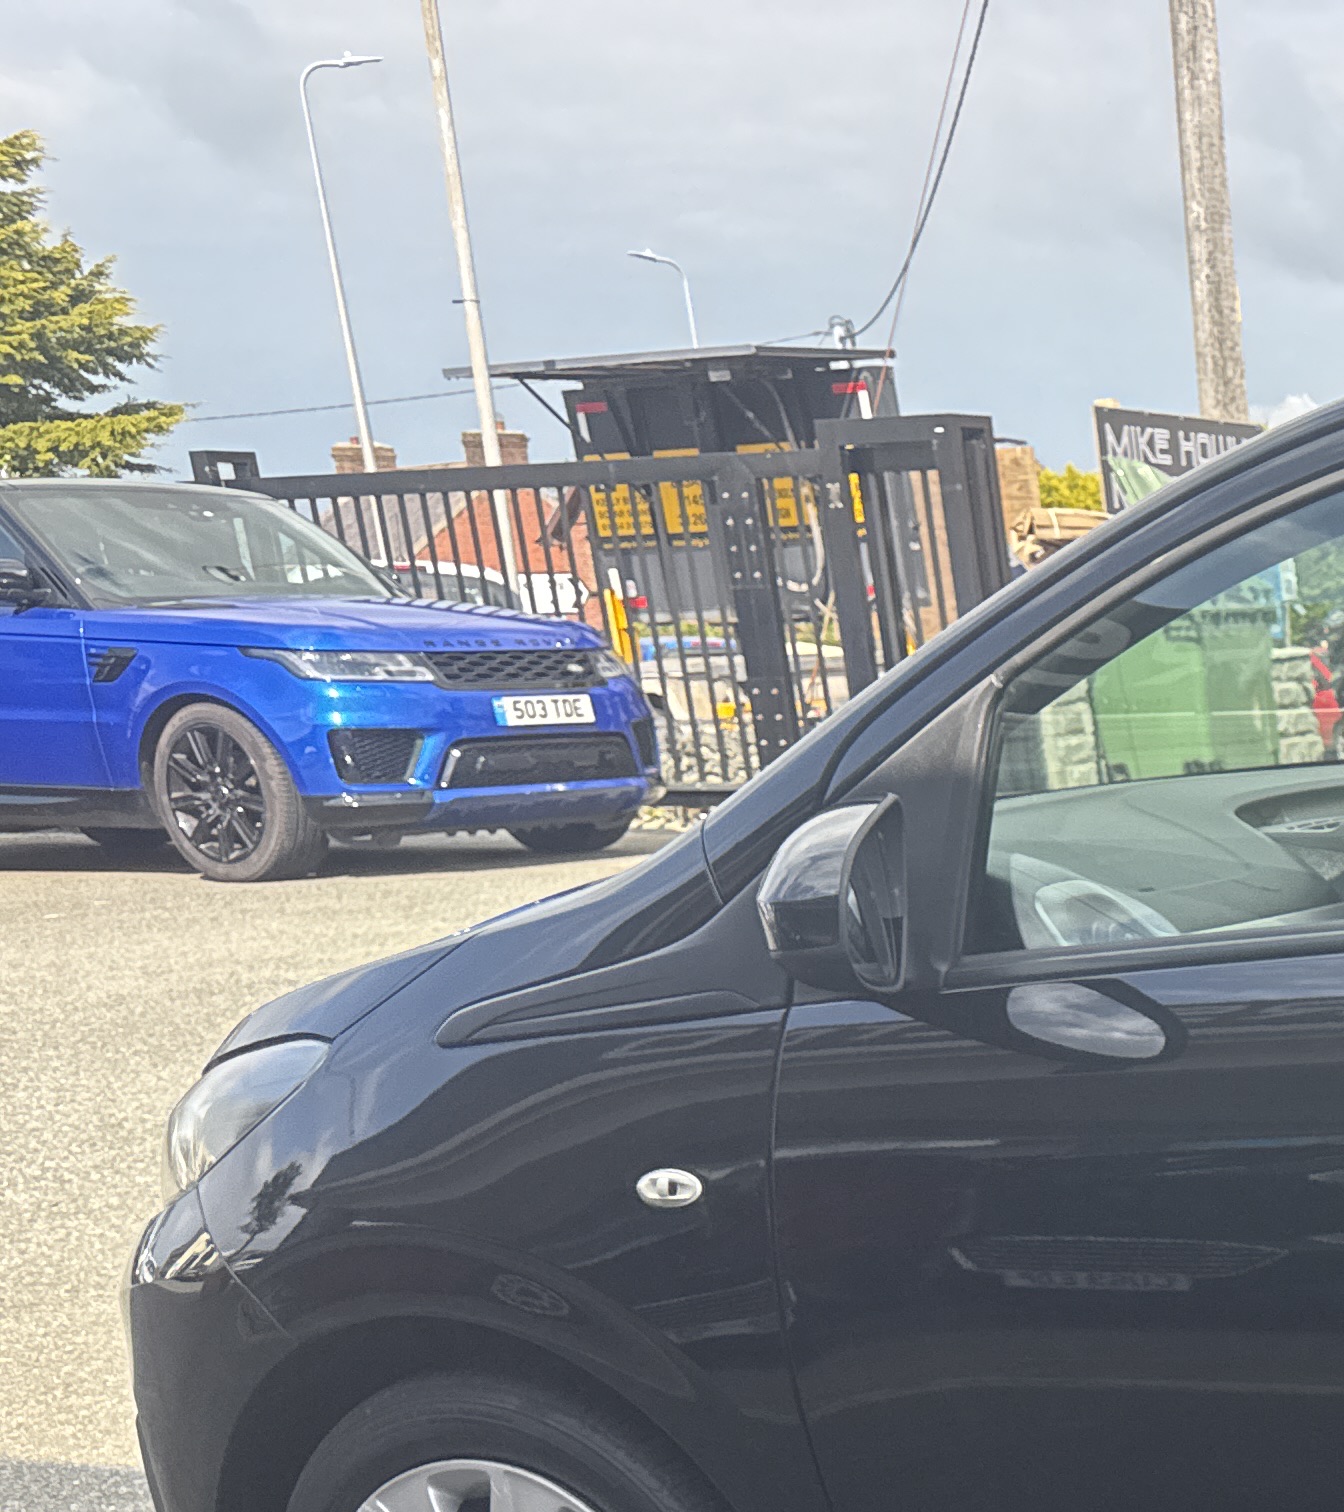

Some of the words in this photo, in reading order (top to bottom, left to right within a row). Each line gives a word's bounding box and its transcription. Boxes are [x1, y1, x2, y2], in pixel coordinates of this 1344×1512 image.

[1104, 422, 1173, 466] MIKE
[512, 699, 549, 720] 503
[551, 697, 585, 719] TDE
